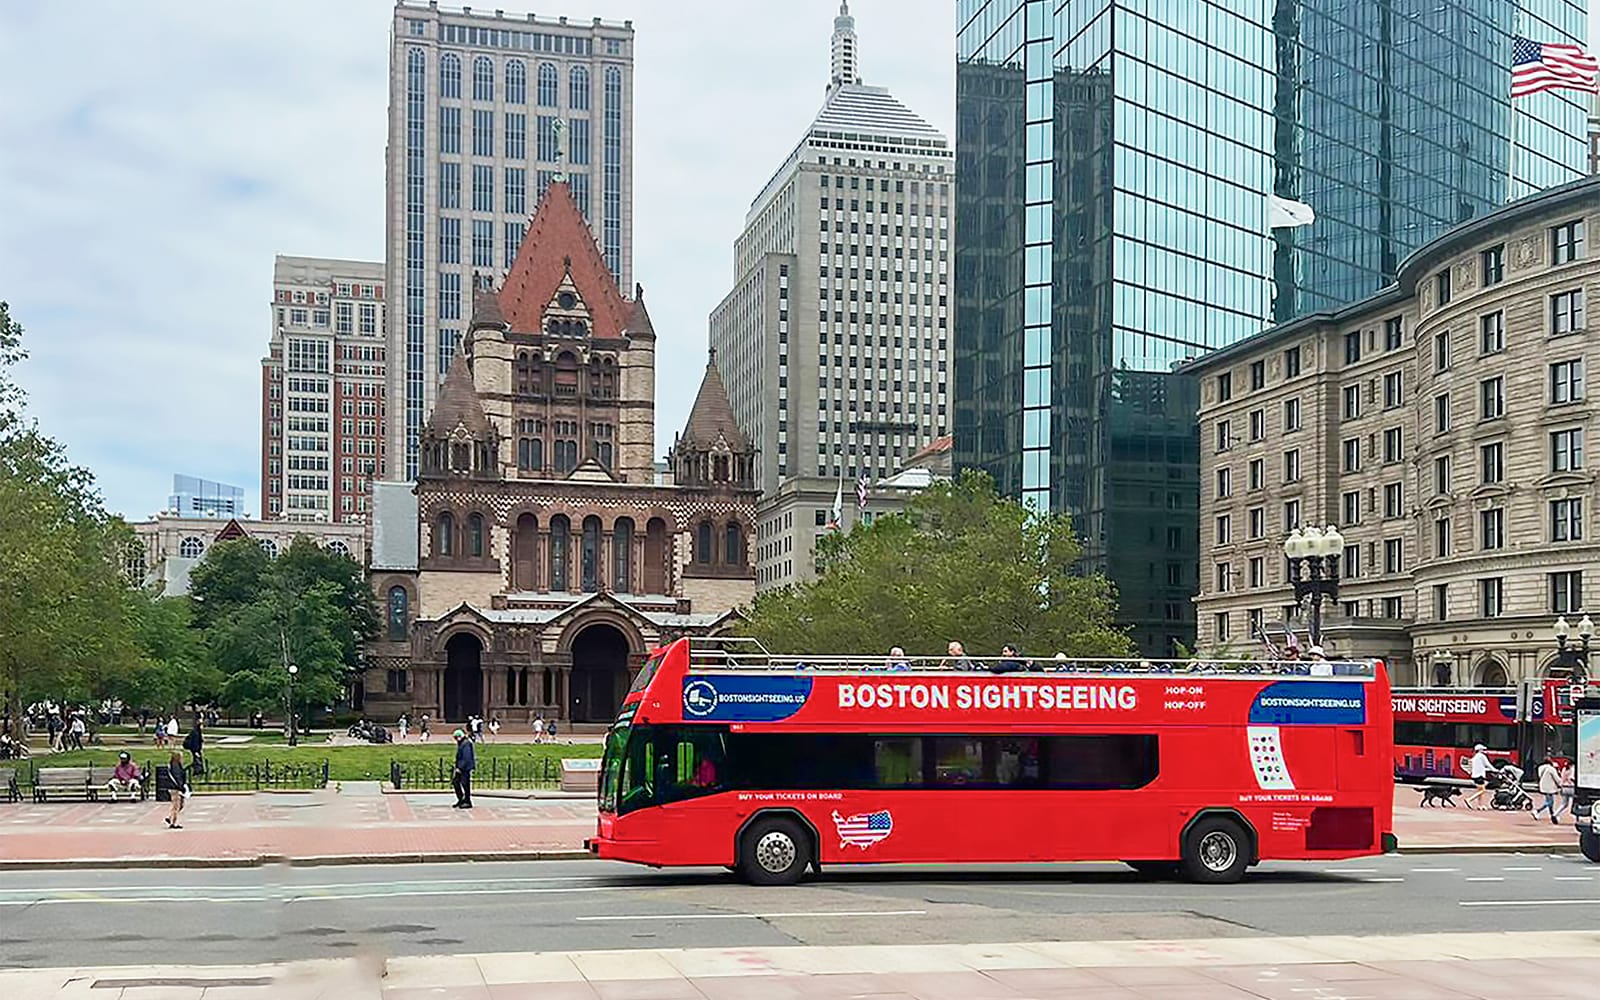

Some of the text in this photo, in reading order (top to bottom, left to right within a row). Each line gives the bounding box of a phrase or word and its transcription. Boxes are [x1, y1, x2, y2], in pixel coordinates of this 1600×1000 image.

[1165, 686, 1203, 694] HOP-ON
[719, 694, 806, 704] BOSTONSIGHTSEEING.US
[838, 684, 1136, 709] BOSTON SIGHTSEEING
[1164, 701, 1206, 710] HOP-OFF
[1261, 698, 1361, 708] BOSTONSIGHTSEEING.US
[1417, 699, 1487, 714] SIGHTSEEING
[739, 792, 843, 801] BUY YOUR TICKETS ON BOARD
